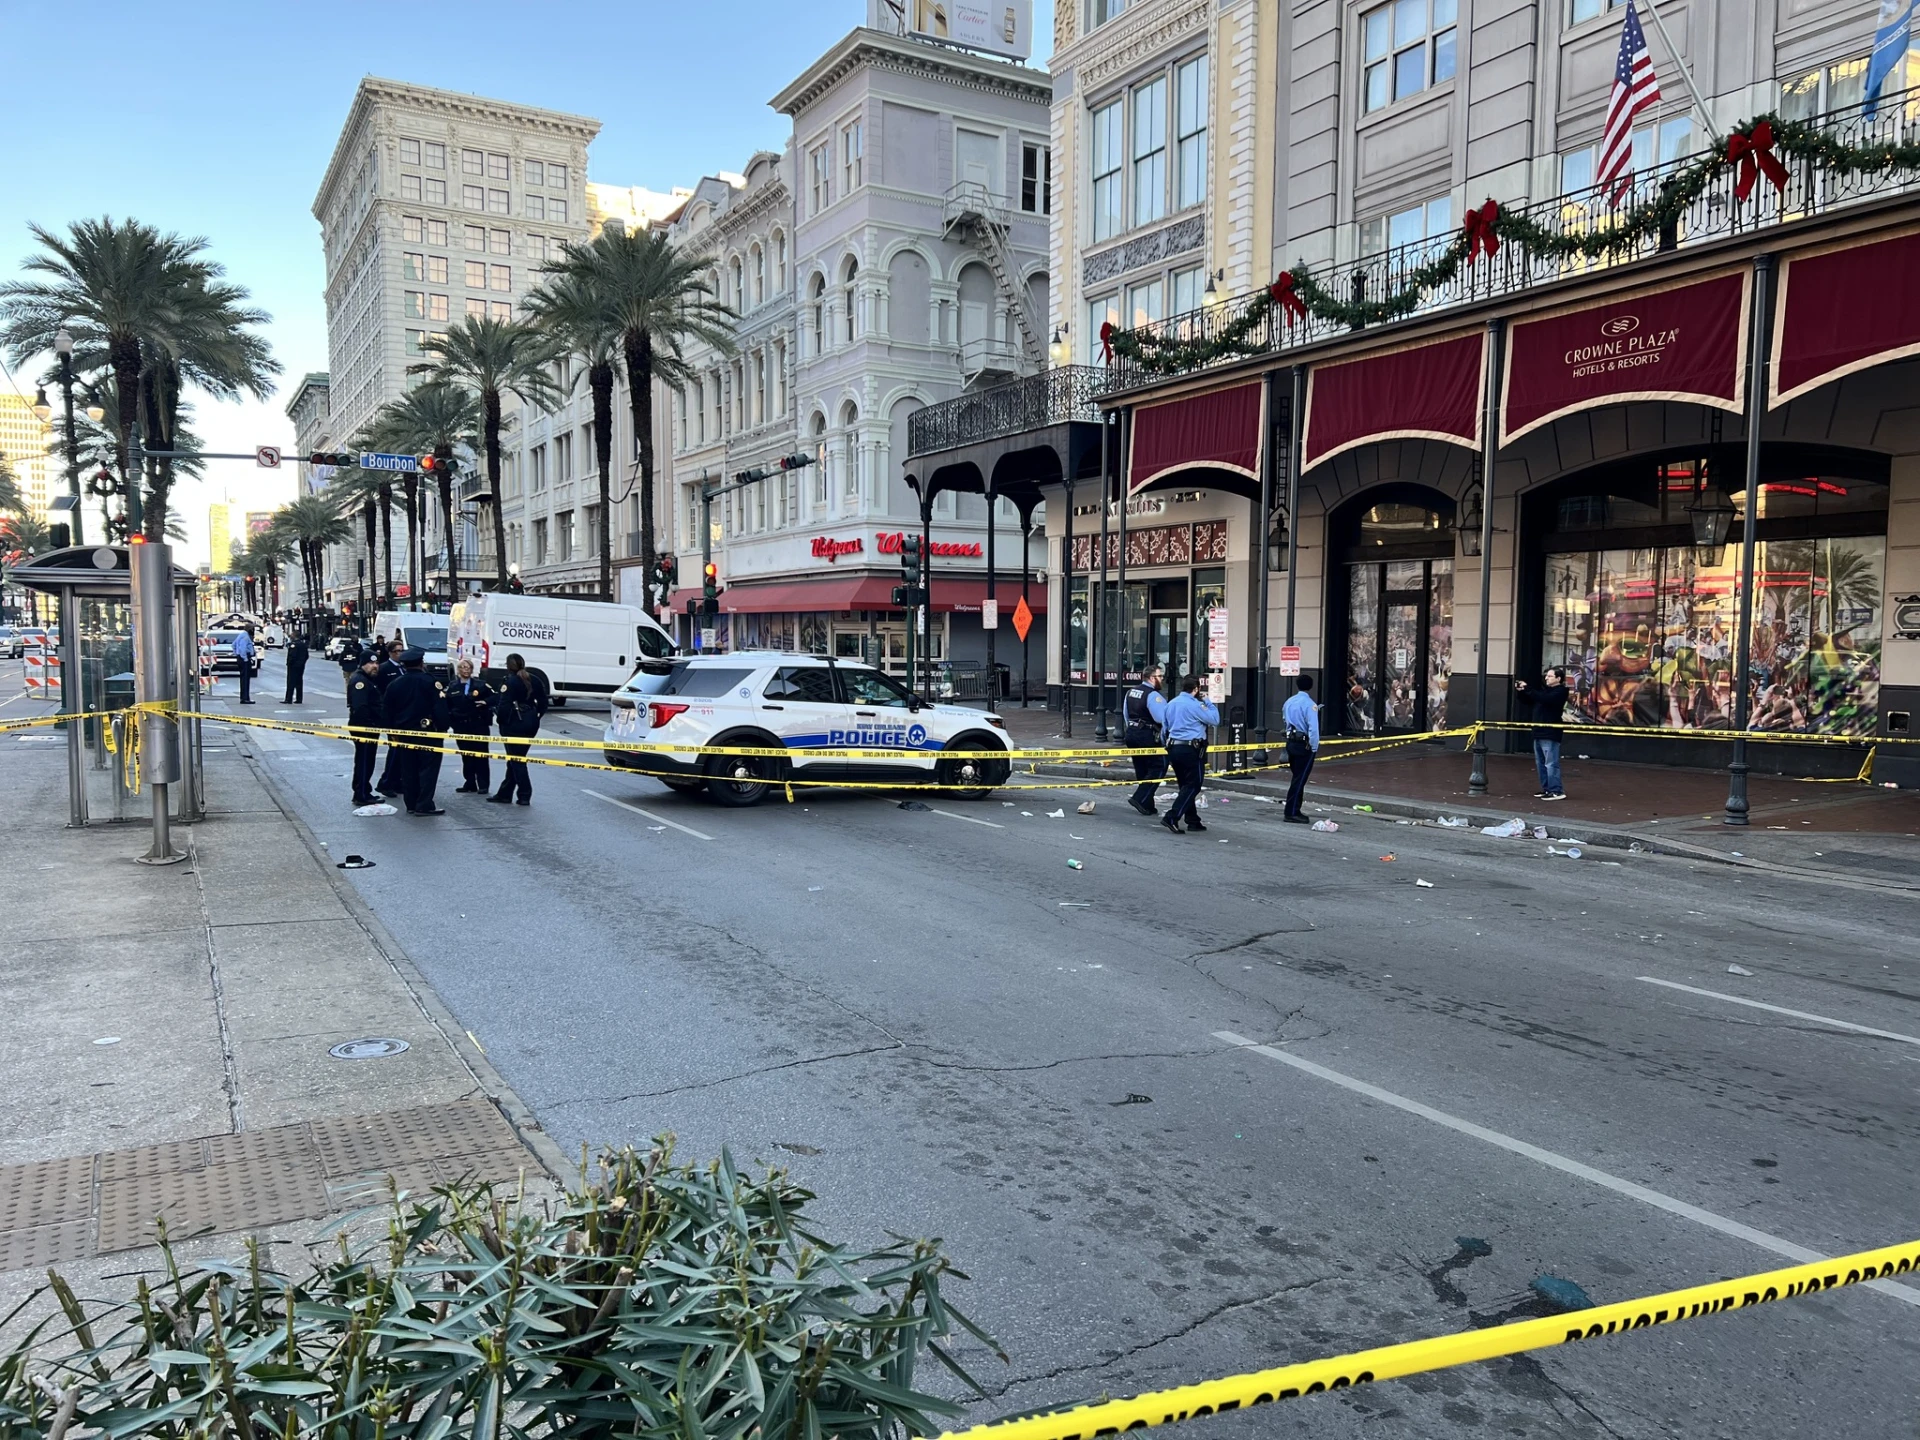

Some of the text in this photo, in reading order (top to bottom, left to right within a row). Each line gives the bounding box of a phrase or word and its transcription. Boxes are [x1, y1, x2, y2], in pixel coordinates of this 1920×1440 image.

[957, 10, 986, 24] Cartier
[1565, 329, 1677, 364] CROWNE PLAZA
[1572, 352, 1660, 378] HOTELS & RESORTS
[368, 454, 414, 470] Bourbon
[811, 536, 863, 562] Walgreens
[876, 532, 983, 560] Wreens
[498, 620, 560, 632] ORLEANS PARISH
[502, 627, 555, 640] CORONER
[1126, 672, 1141, 680] CORN
[829, 730, 906, 746] POLICE
